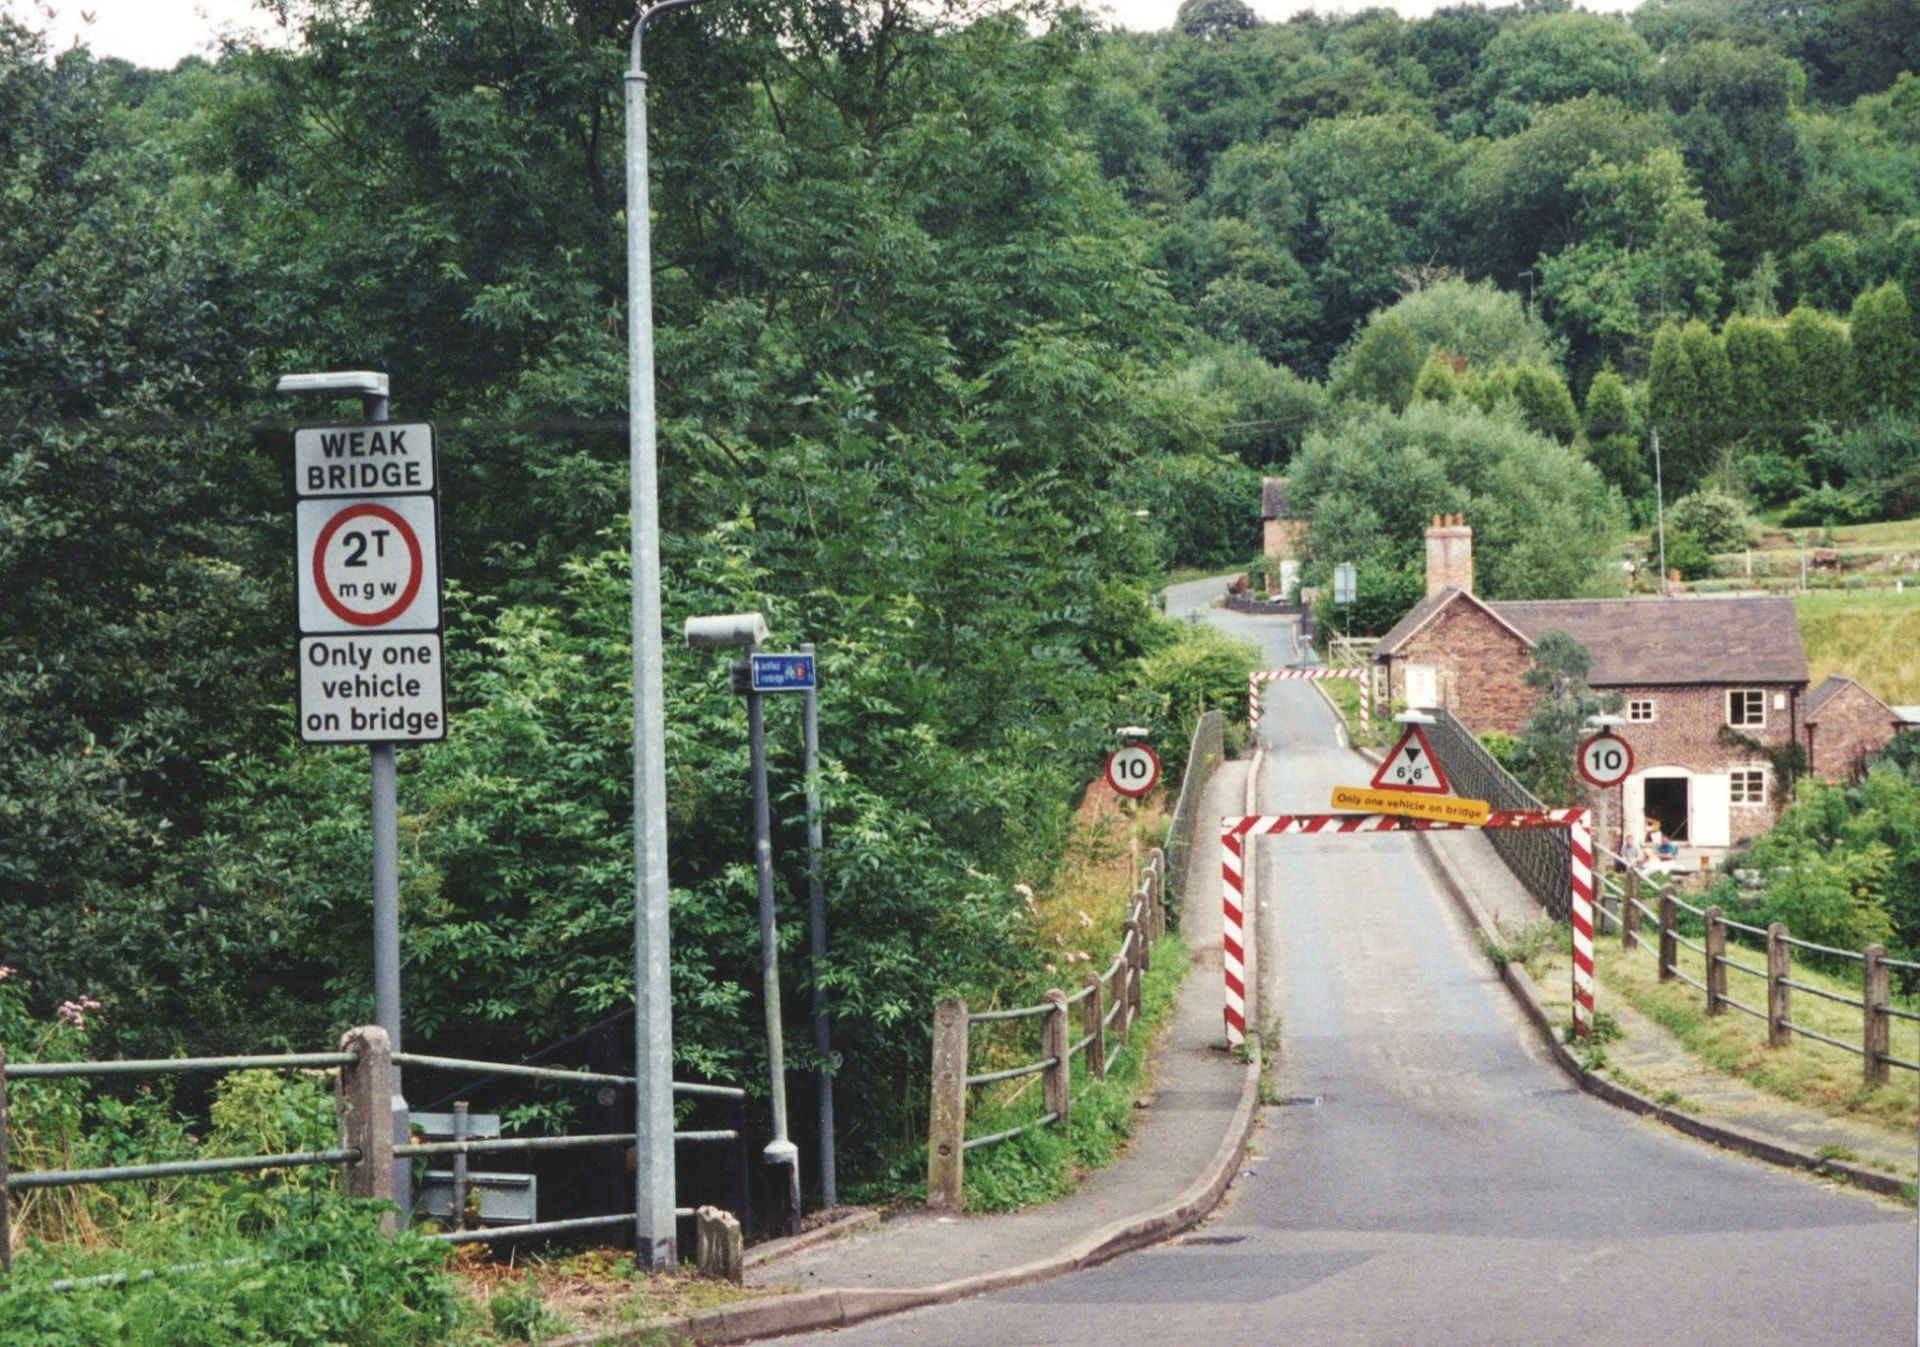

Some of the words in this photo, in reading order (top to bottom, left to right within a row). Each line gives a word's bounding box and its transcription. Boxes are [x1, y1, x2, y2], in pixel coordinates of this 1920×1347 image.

[320, 431, 407, 458] WEAK
[307, 462, 421, 490] BRIDGE
[342, 530, 390, 567] 2T
[308, 642, 372, 670] Only
[382, 646, 431, 665] one
[322, 673, 420, 698] vehicle
[307, 713, 339, 731] on
[350, 707, 438, 734] bridge
[1118, 758, 1147, 779] 10
[1592, 750, 1621, 770] 10
[1337, 793, 1361, 806] Only
[1365, 796, 1384, 807] one
[1387, 798, 1425, 811] vehicle
[1429, 804, 1442, 814] on
[1446, 804, 1481, 818] bridge
